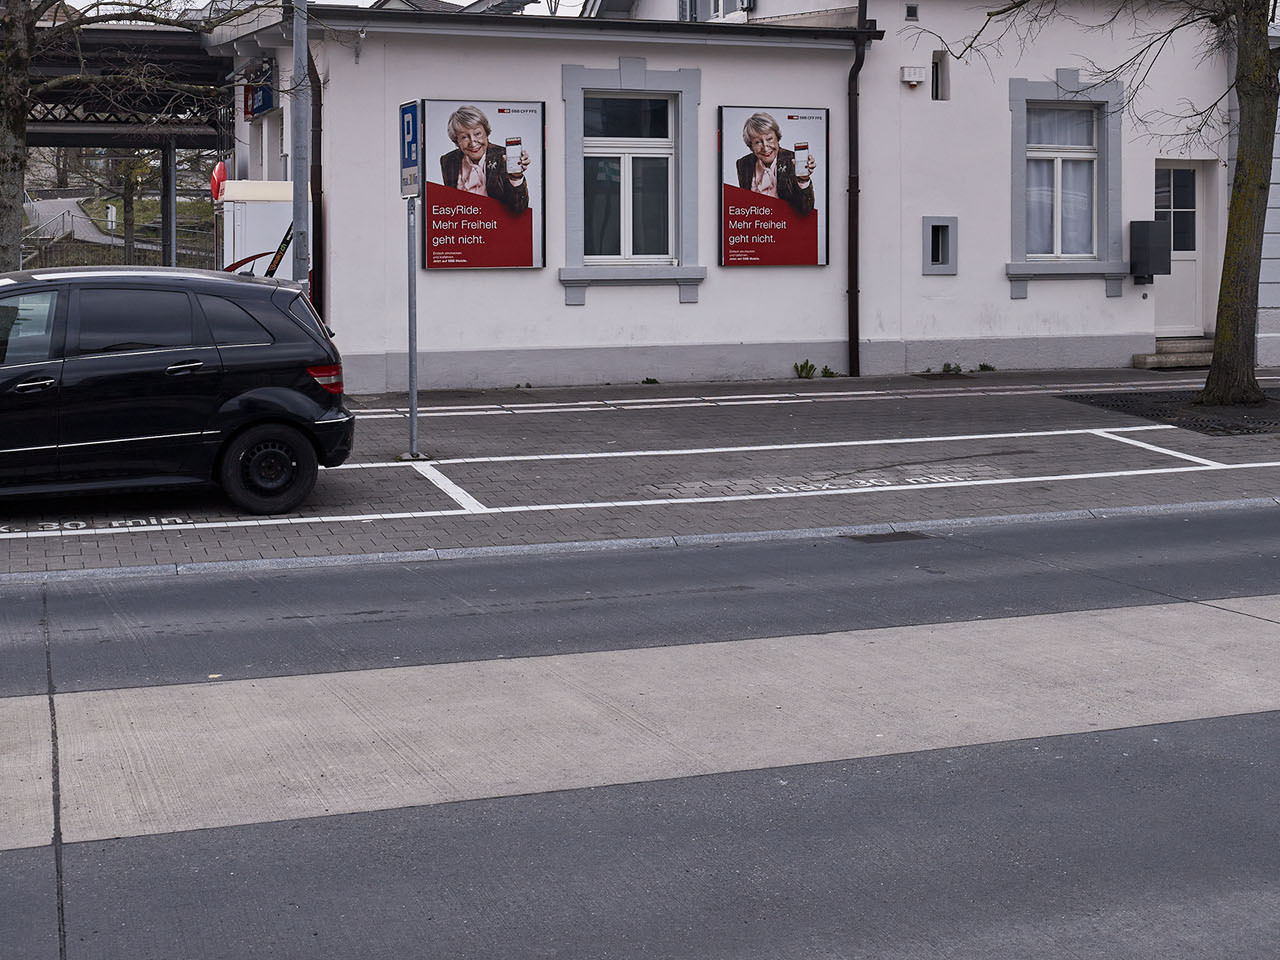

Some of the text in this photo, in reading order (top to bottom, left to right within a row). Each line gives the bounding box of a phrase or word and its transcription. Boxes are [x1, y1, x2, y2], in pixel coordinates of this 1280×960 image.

[432, 205, 482, 217] EasyRide:
[728, 206, 773, 217] EasyRide:
[432, 220, 497, 229] Mehr Freiheit
[728, 220, 787, 229] Mehr Freiheit
[432, 235, 485, 246] geht nicht.
[728, 234, 776, 245] geht nicht.
[766, 475, 973, 493] max. 30 min.
[38, 521, 87, 531] 30
[111, 516, 194, 527] min.
